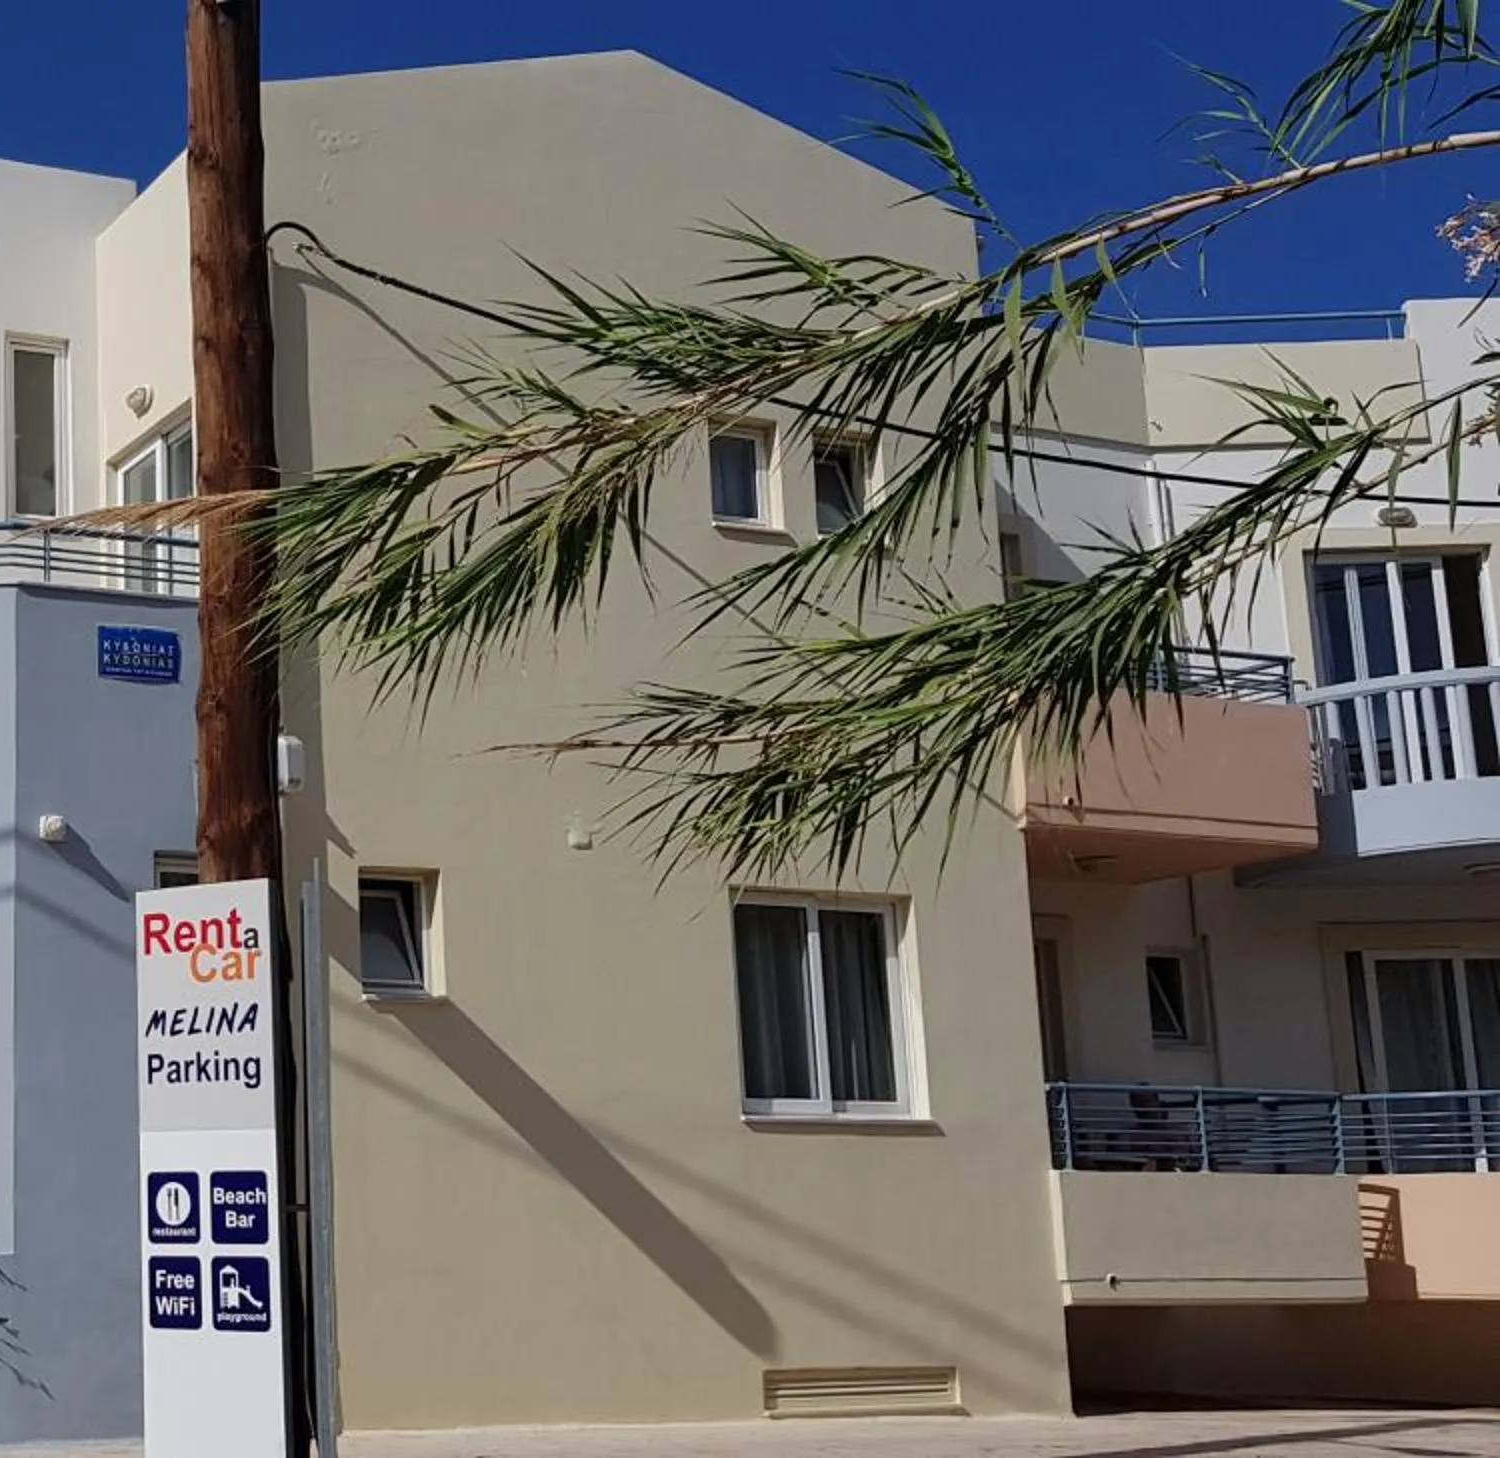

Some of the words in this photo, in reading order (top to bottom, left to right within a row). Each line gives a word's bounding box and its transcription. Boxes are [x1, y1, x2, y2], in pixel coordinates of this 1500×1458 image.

[103, 652, 174, 669] KYDONIAS
[142, 907, 243, 956] Rent
[243, 927, 260, 949] a
[190, 942, 261, 983] Car
[145, 1002, 259, 1037] MELINA
[147, 1051, 261, 1089] Parking
[213, 1187, 267, 1205] Beach
[225, 1210, 256, 1228] Bar
[152, 1227, 196, 1237] restaurant
[155, 1269, 195, 1289] Free
[155, 1296, 196, 1316] WiFi
[217, 1312, 267, 1323] playground
